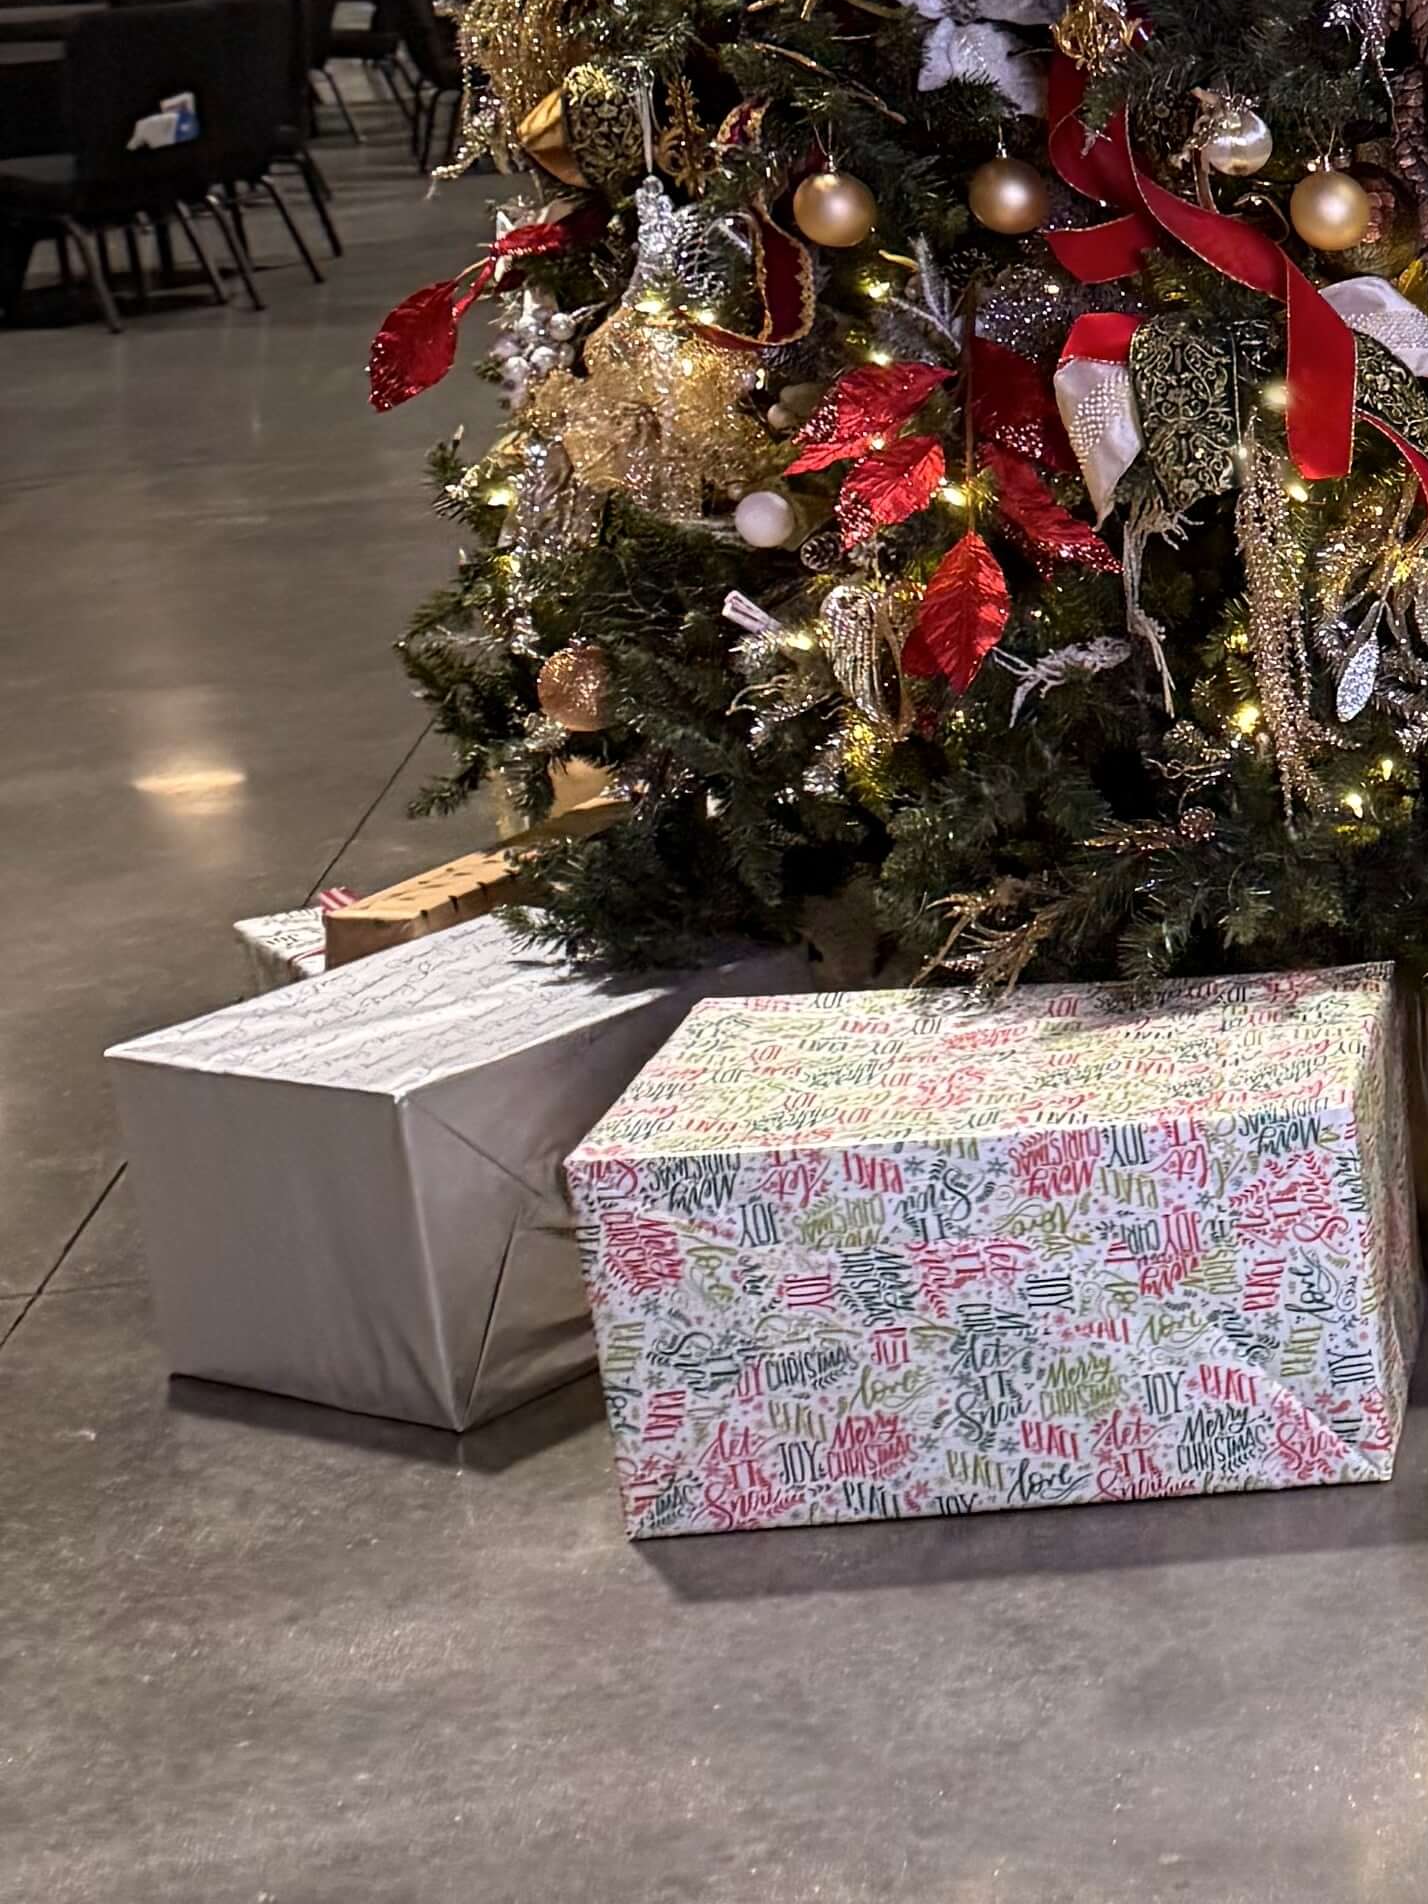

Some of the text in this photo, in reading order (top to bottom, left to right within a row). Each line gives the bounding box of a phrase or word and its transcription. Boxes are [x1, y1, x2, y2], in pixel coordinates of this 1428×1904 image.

[910, 1020, 942, 1034] JOY
[1041, 998, 1079, 1017] JOY
[837, 1108, 872, 1125] JOY
[1107, 1124, 1150, 1168] JOY
[737, 1201, 785, 1246] JOY
[784, 1273, 836, 1312] JOY
[1025, 1273, 1075, 1314] JOY
[1043, 1352, 1114, 1390] Merry
[1200, 1364, 1258, 1407] PEACE
[1327, 1349, 1376, 1388] JOY
[1142, 1371, 1186, 1418] JOY
[831, 1409, 900, 1450] Merry
[1180, 1402, 1250, 1444] Merry
[779, 1440, 822, 1486] JOY
[826, 1432, 919, 1483] CHRISTMAS
[1176, 1423, 1268, 1475] CHRISTMAS
[1006, 1457, 1094, 1506] love
